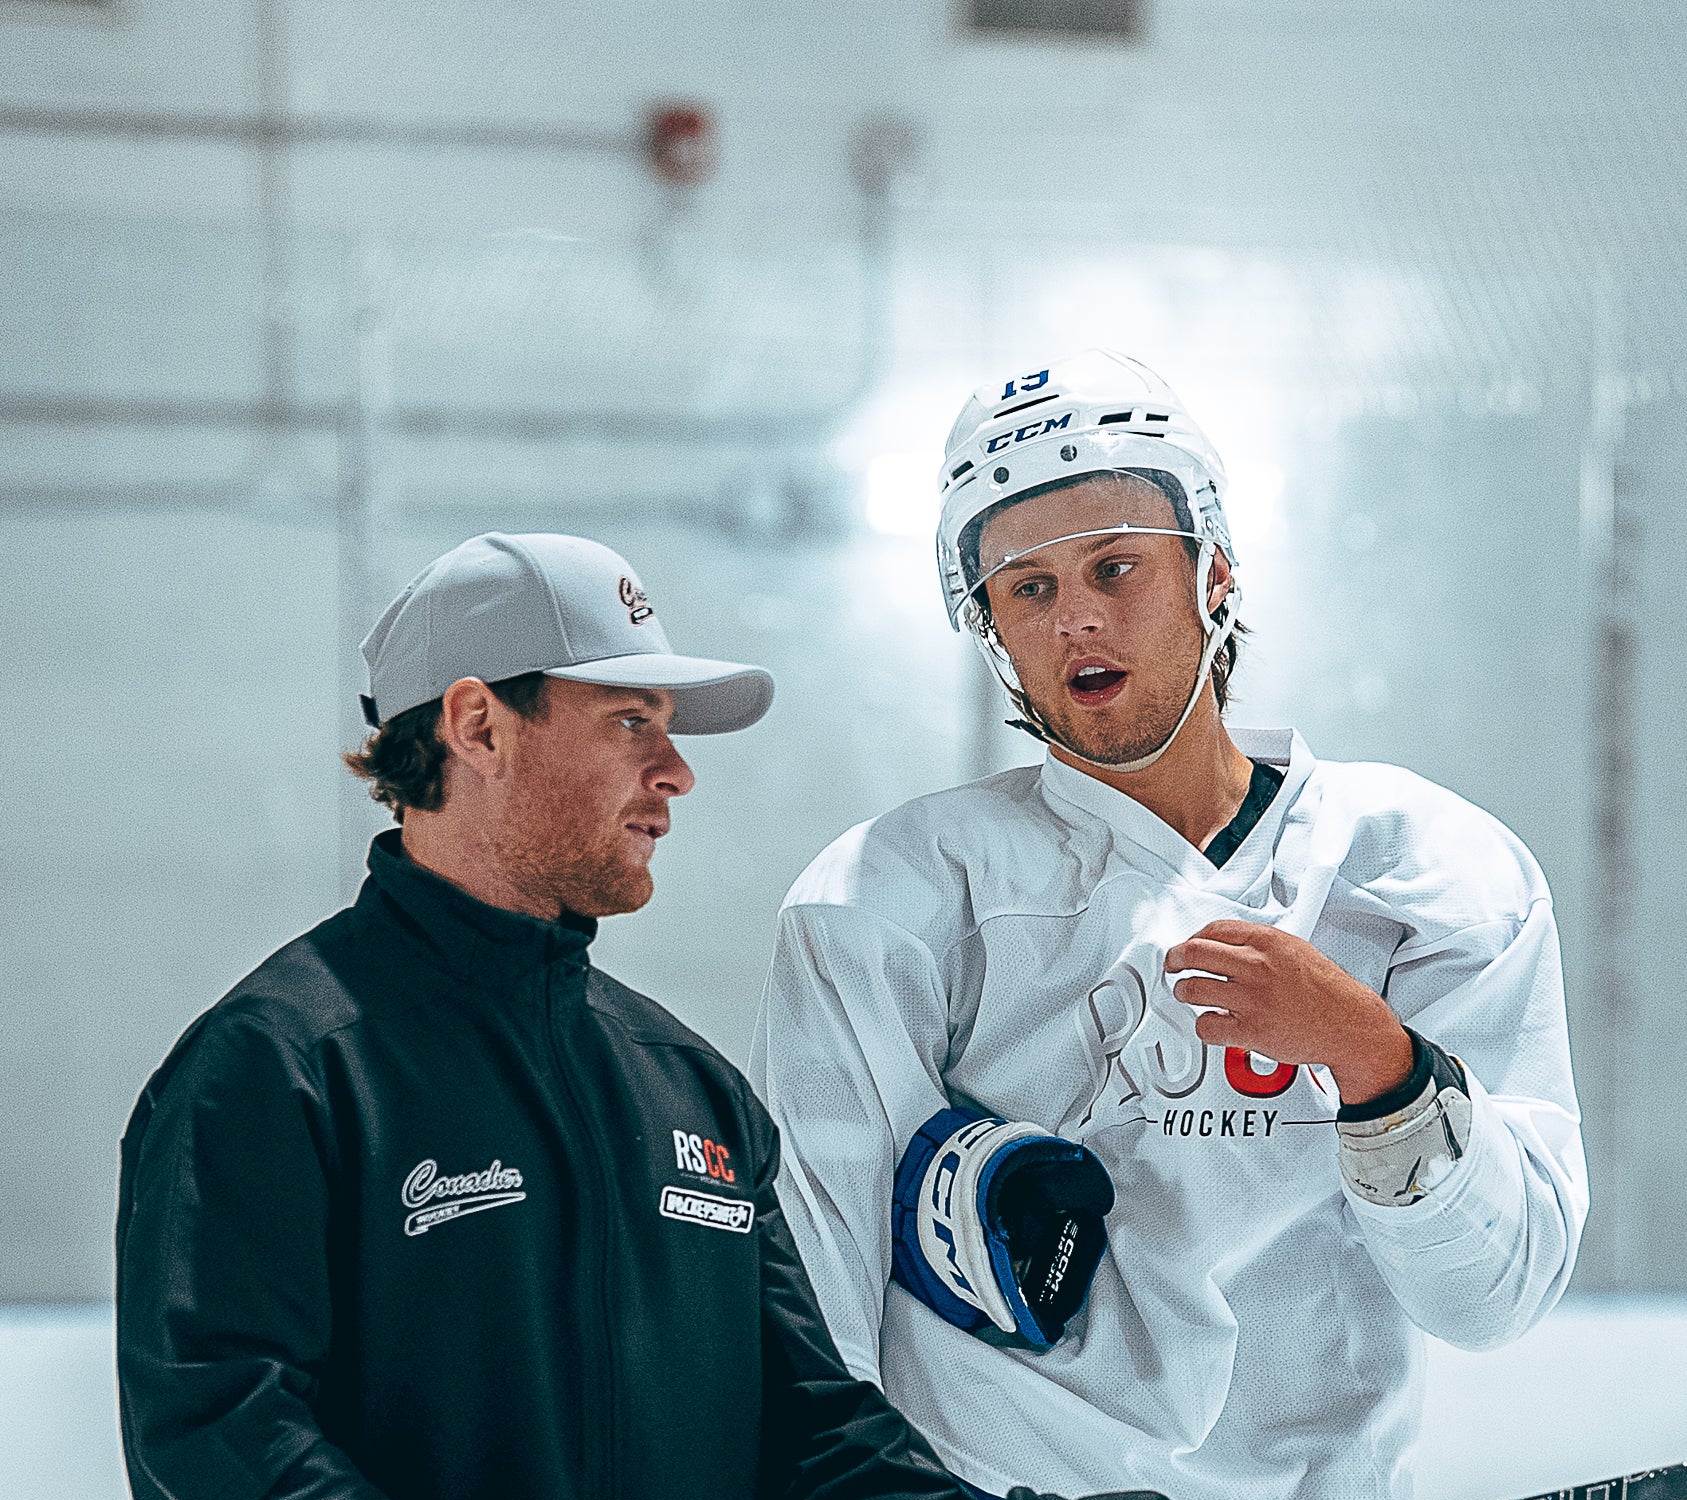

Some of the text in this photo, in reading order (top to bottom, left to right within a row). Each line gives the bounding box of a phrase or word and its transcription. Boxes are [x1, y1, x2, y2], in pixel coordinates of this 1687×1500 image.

[986, 412, 1073, 454] CCM
[1074, 962, 1328, 1130] RS
[1162, 1108, 1280, 1138] HOCKEY
[671, 1129, 736, 1183] RSCC
[1050, 1237, 1076, 1293] CCM
